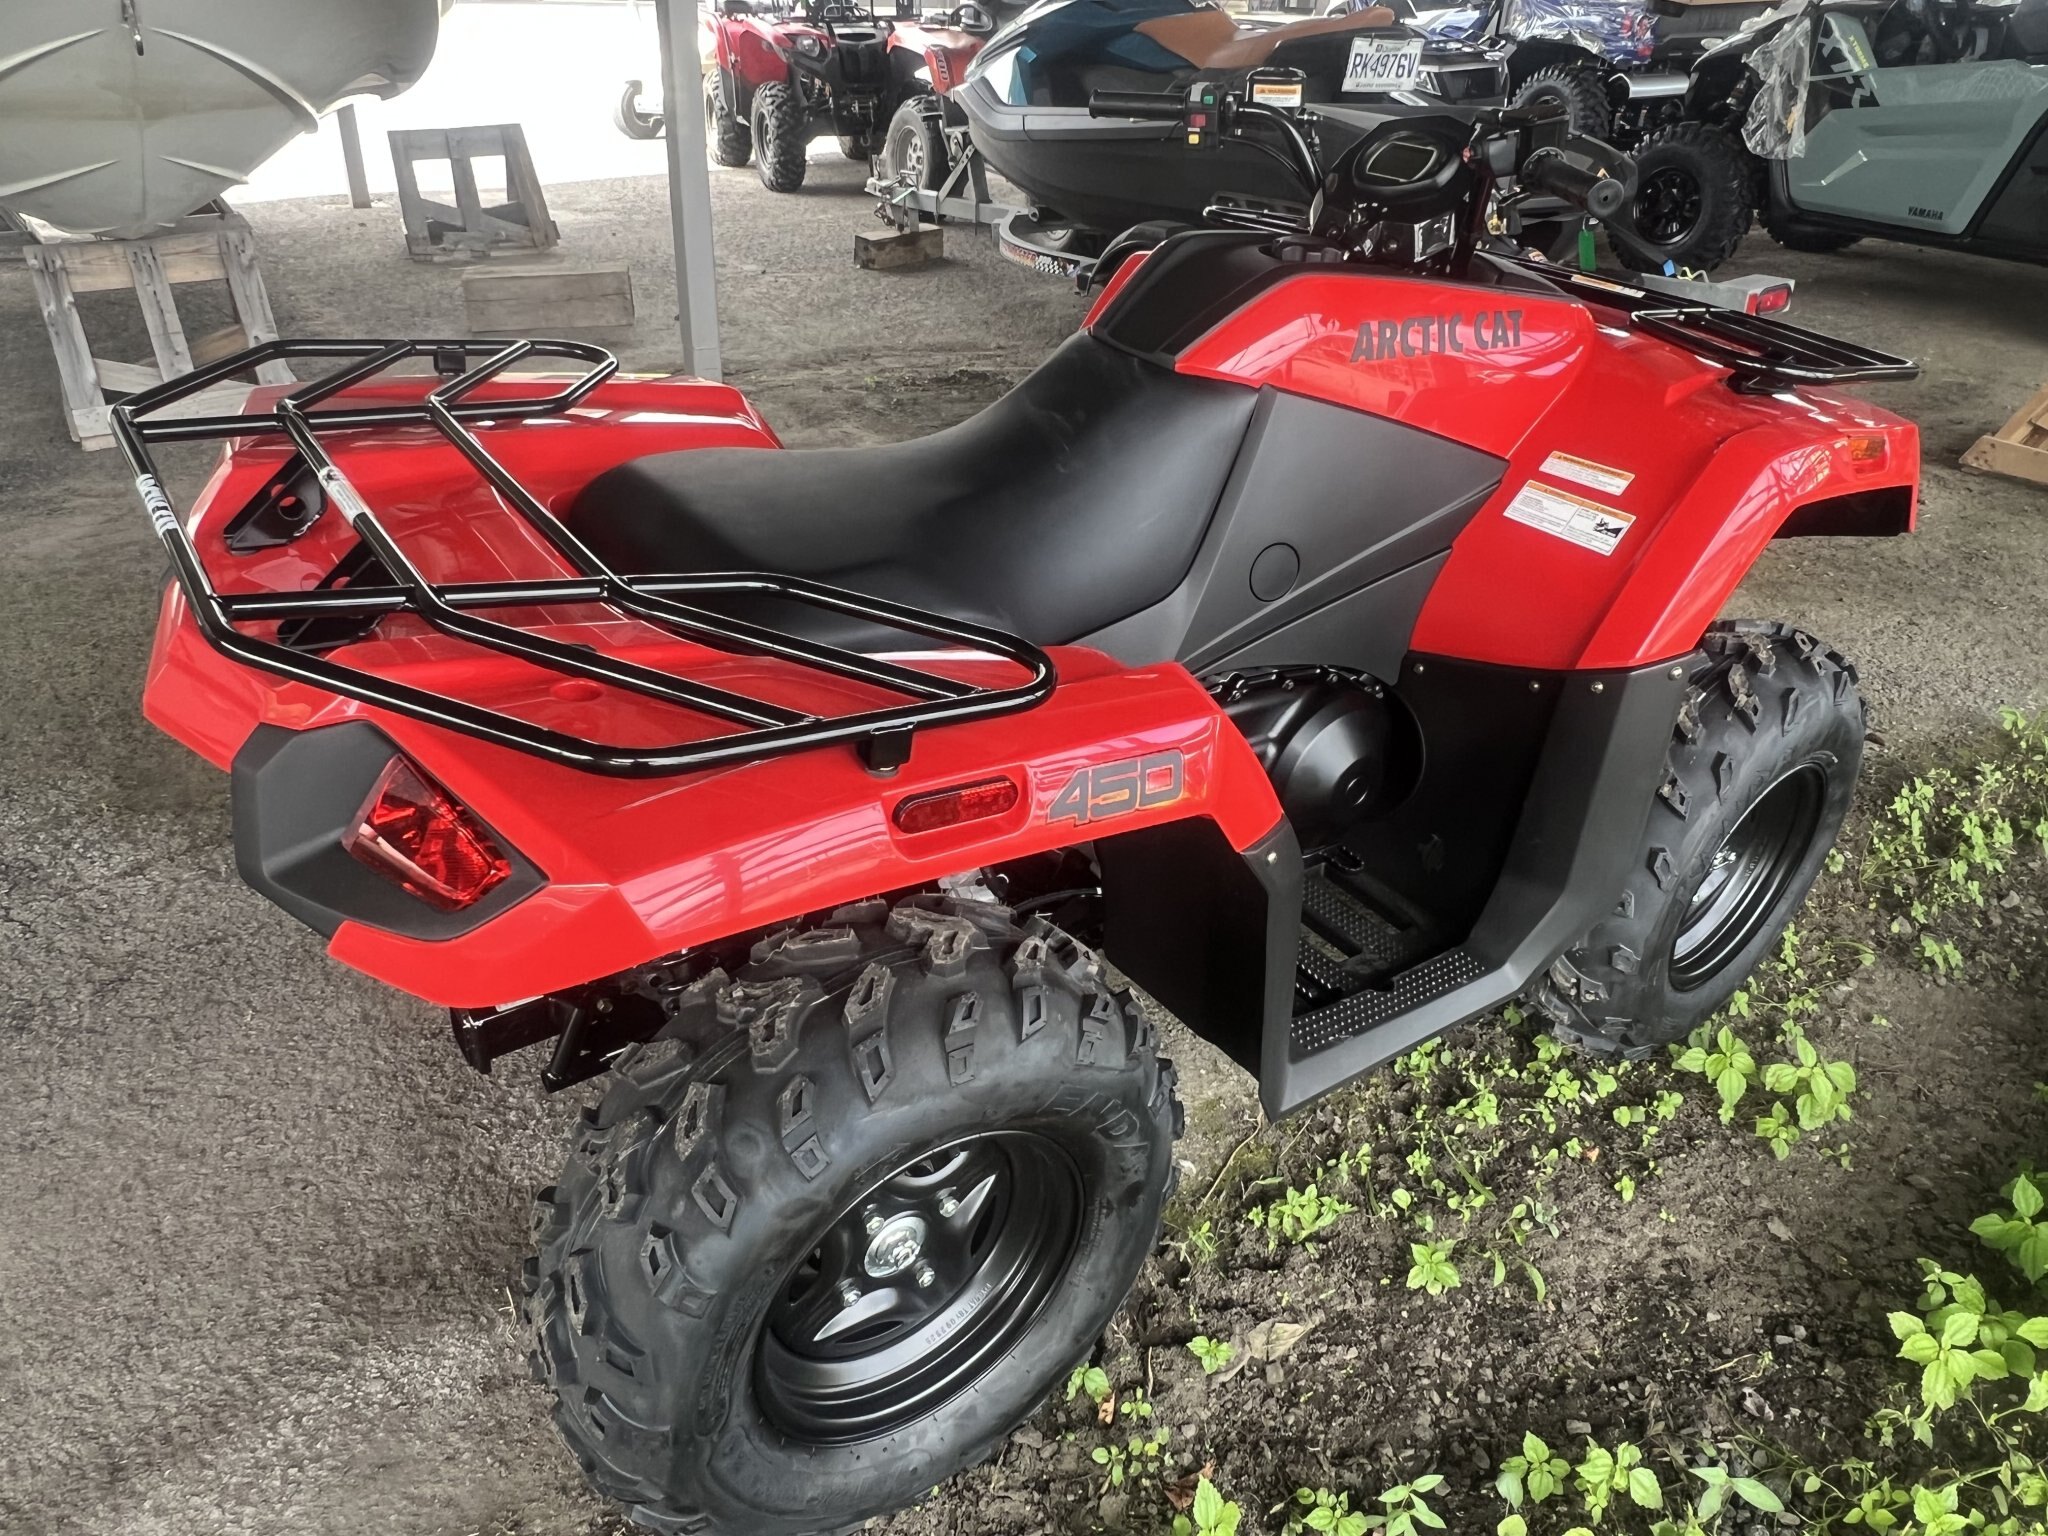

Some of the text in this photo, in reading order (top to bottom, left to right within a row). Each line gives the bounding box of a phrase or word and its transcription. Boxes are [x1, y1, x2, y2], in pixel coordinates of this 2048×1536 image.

[1349, 52, 1418, 78] RK4976V
[1908, 206, 1944, 220] YAMAHA
[1350, 309, 1523, 363] ARCTIC CAT
[1046, 748, 1185, 827] 450
